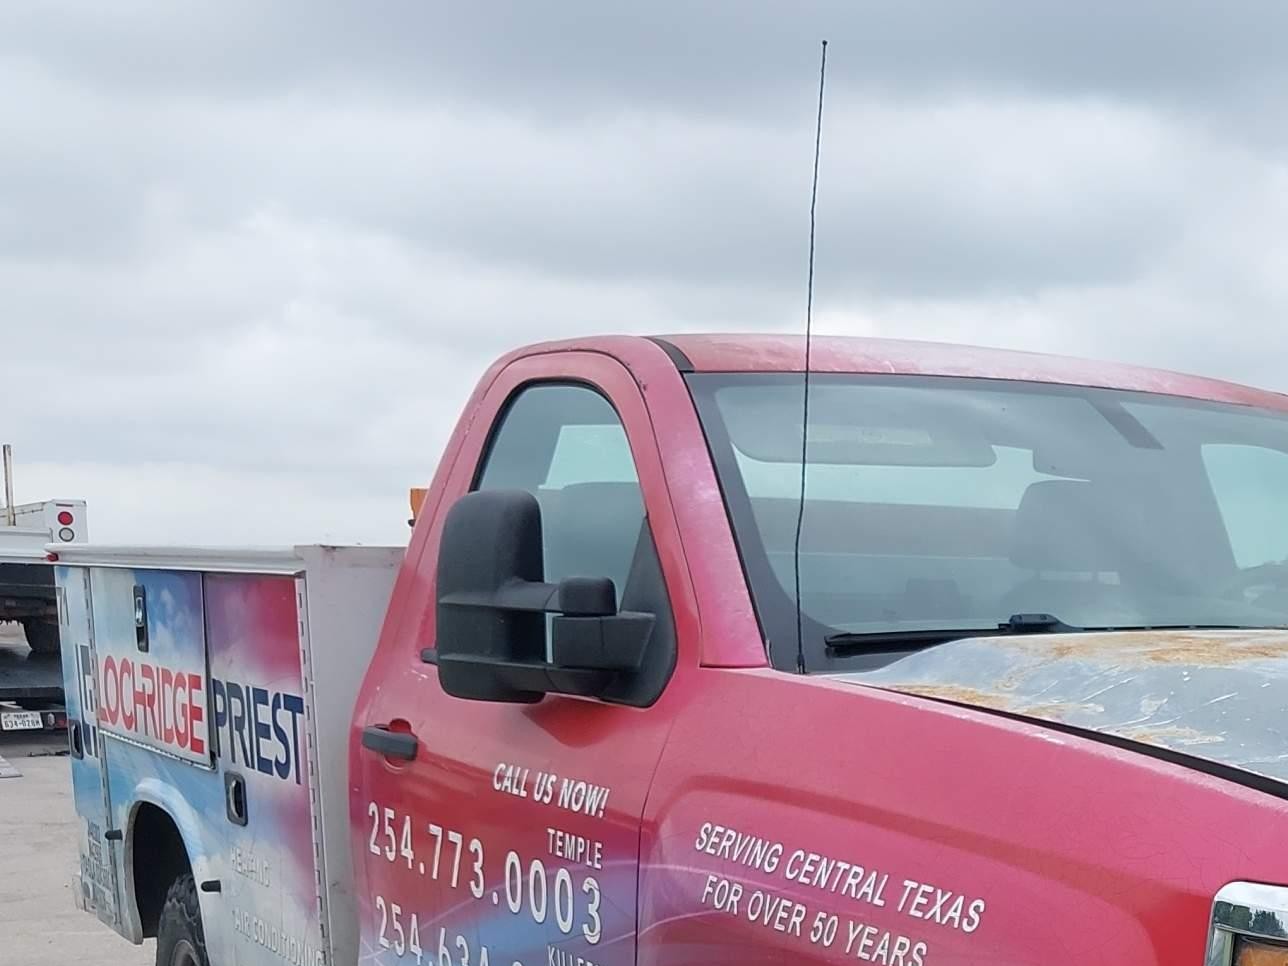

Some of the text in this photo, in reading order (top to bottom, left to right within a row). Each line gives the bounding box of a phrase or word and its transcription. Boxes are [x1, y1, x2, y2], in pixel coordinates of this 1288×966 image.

[97, 655, 205, 755] LOCHRIDGE
[211, 678, 304, 785] PRIEST
[493, 762, 610, 818] CALL US NOW!
[368, 801, 601, 944] 254.773.0003
[547, 828, 602, 869] TEMPLE
[695, 822, 985, 933] SERVING CENTRAL TEXAS
[234, 906, 250, 938] AIR
[701, 875, 743, 916] FOR
[747, 890, 807, 937] OVER
[810, 912, 839, 947] 50
